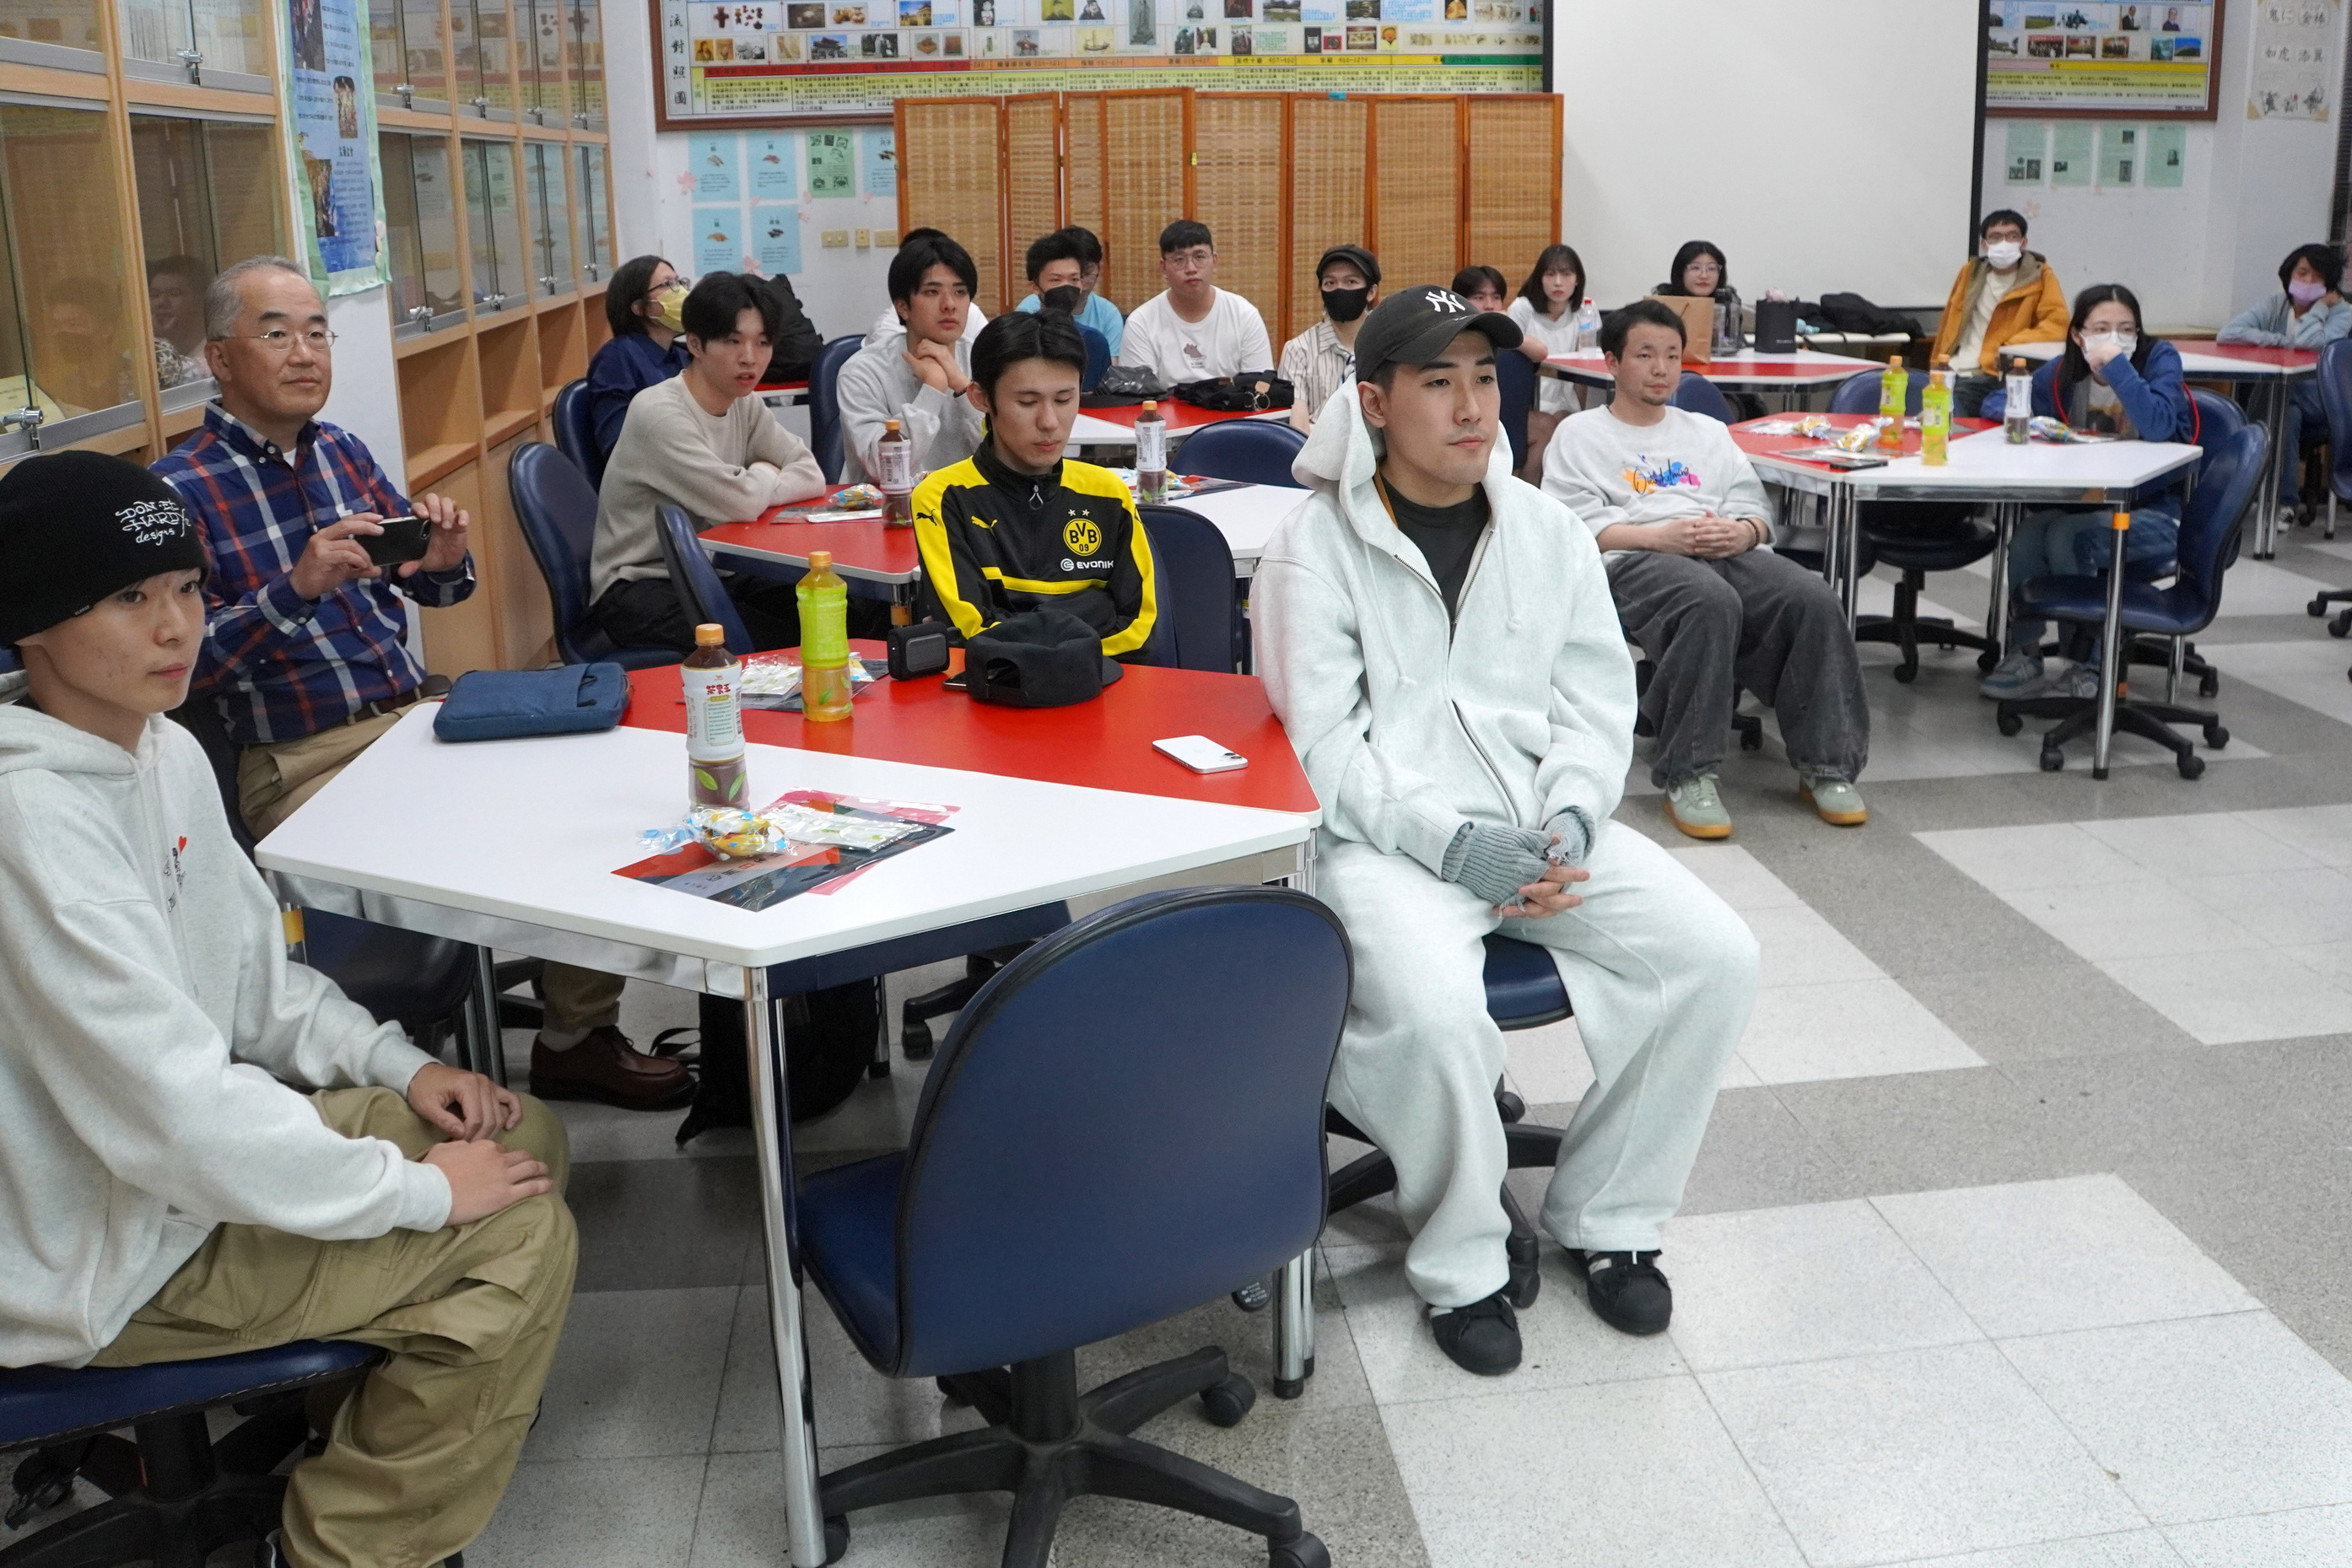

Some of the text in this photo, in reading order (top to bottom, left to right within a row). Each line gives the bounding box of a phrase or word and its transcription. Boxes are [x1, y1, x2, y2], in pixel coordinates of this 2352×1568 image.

[669, 0, 687, 105] 流對照圖
[1425, 290, 1465, 313] NY
[115, 501, 158, 523] DON
[122, 509, 185, 537] HARDY
[136, 528, 175, 547] designs
[1069, 522, 1098, 544] BVB
[1079, 543, 1089, 552] 09
[1076, 560, 1114, 569] EVONIK
[705, 682, 731, 695] 茶裏王
